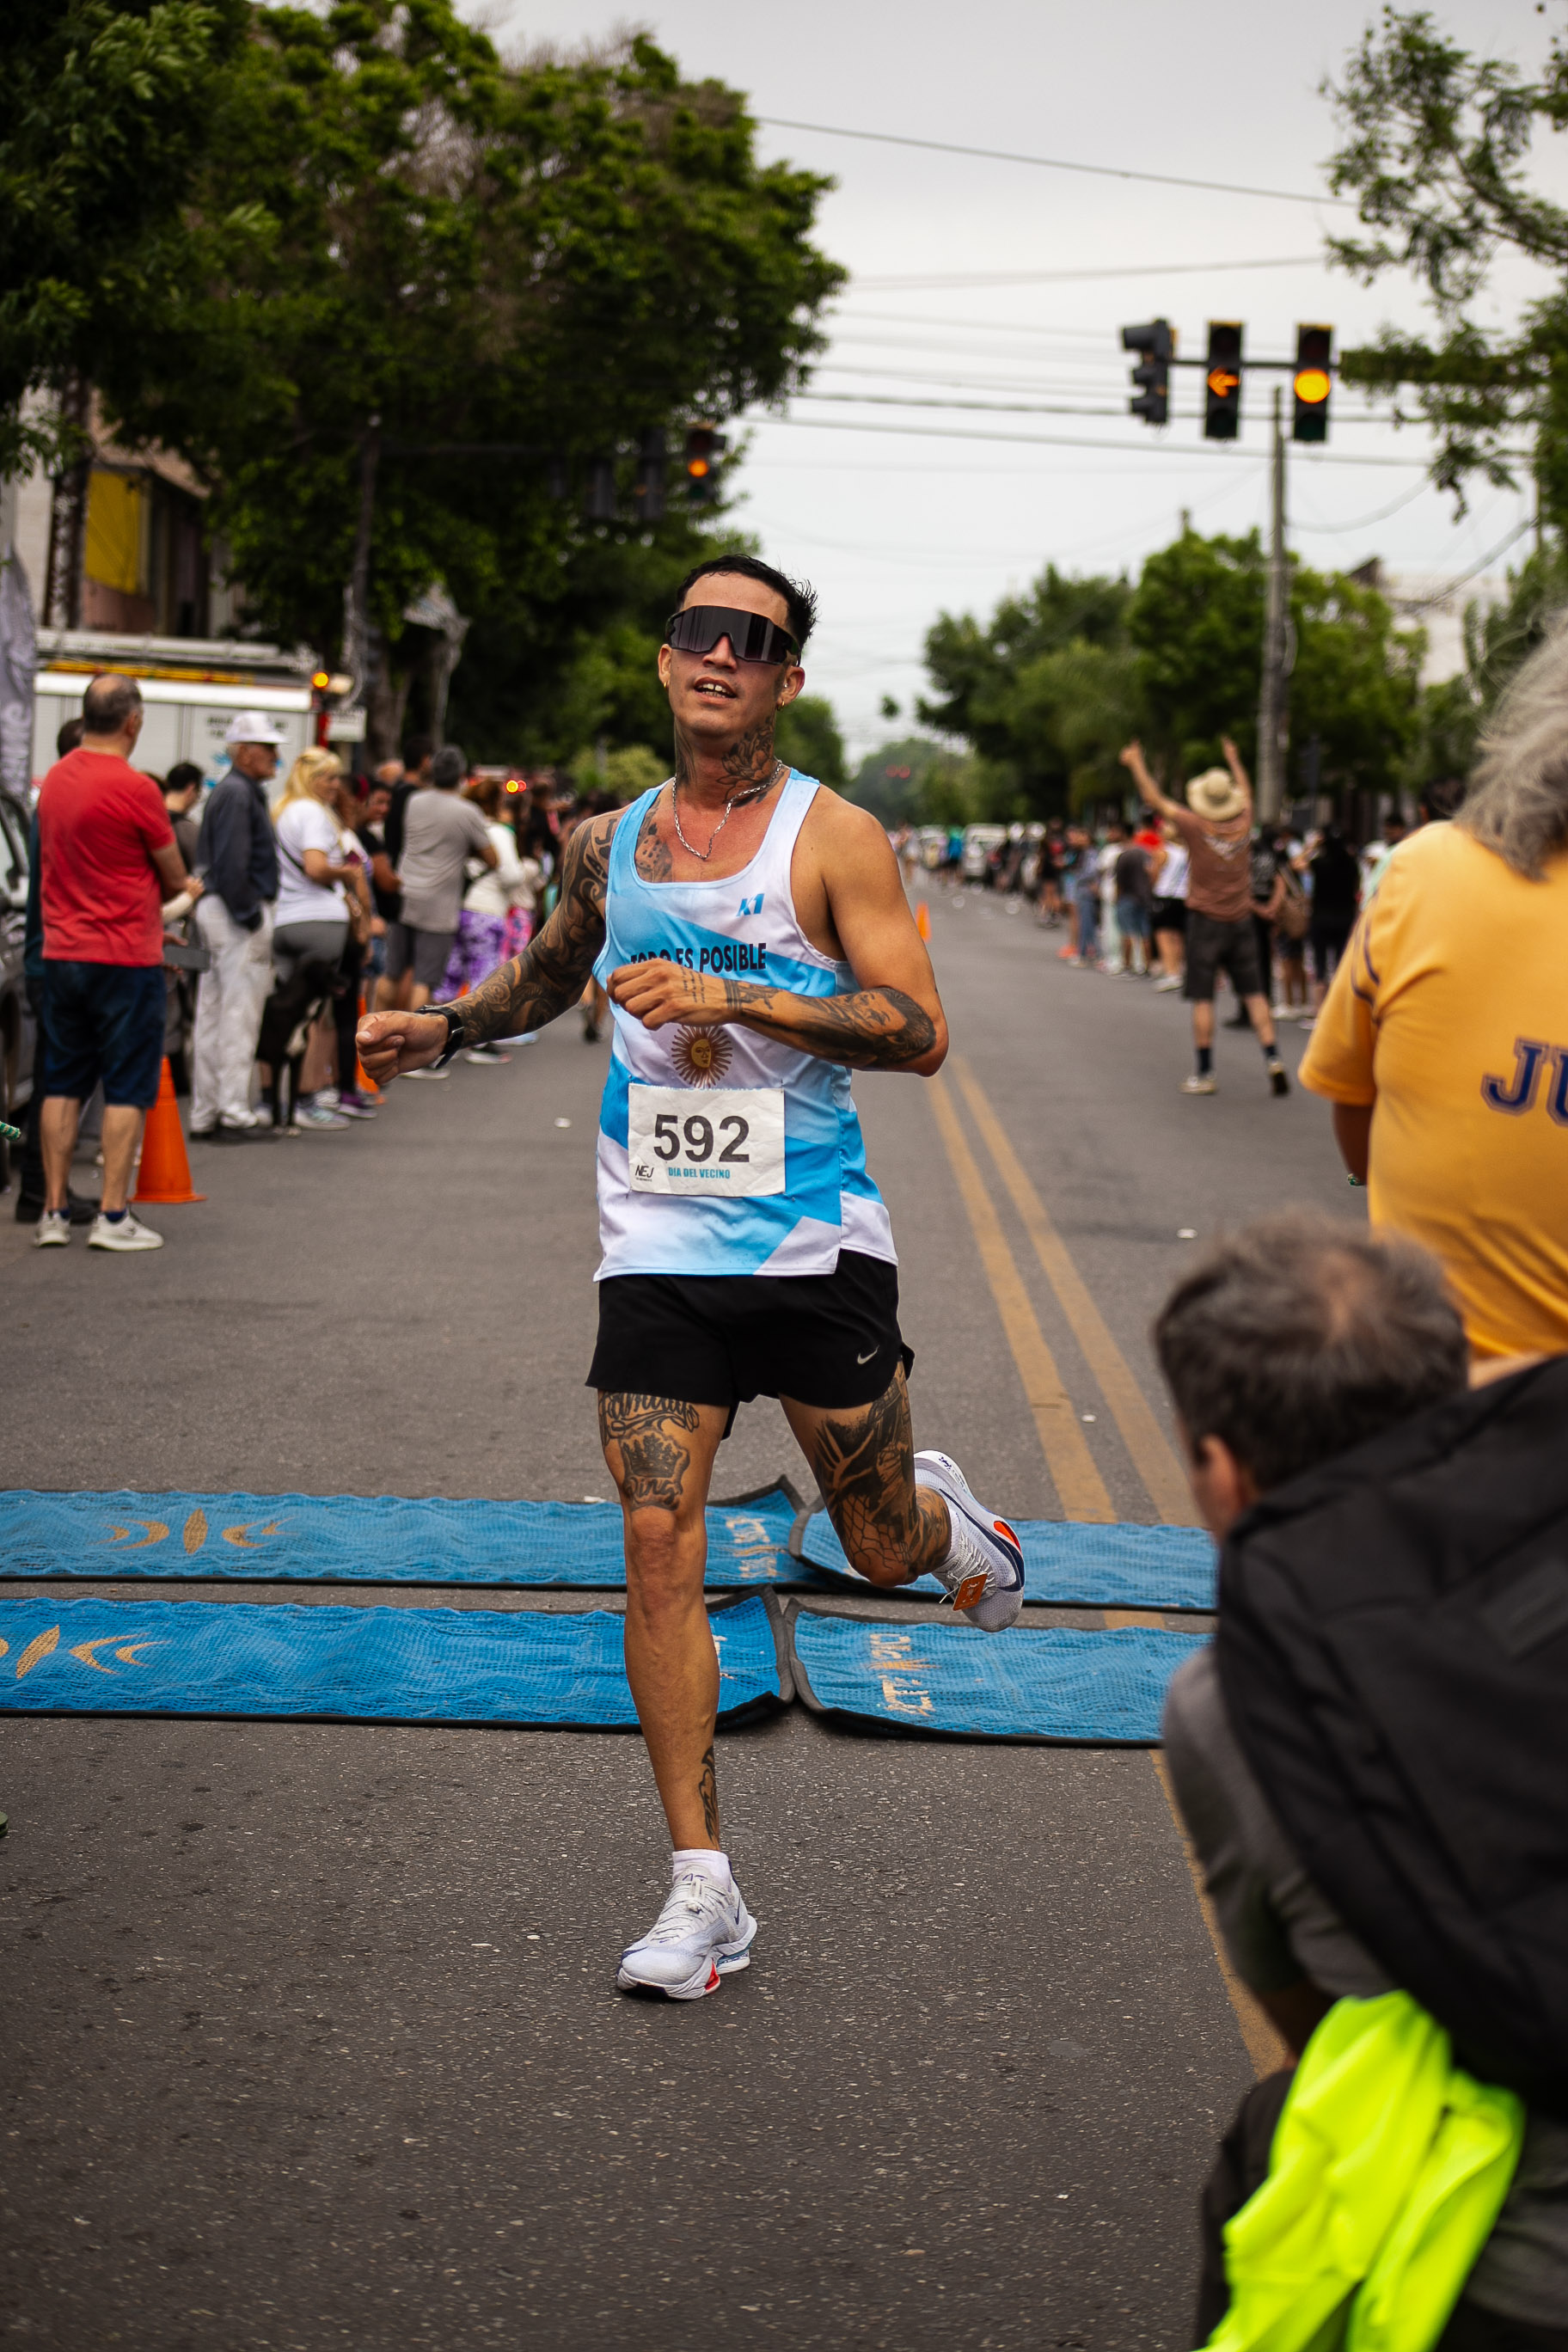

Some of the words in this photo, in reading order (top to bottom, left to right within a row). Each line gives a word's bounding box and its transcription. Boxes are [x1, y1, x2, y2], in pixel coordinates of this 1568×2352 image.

[676, 947, 694, 970] ES
[699, 942, 767, 974] POSIBLE
[653, 1113, 750, 1163] 592
[668, 1167, 682, 1178] DIA
[683, 1167, 698, 1179] DEL
[699, 1168, 731, 1179] VECINO
